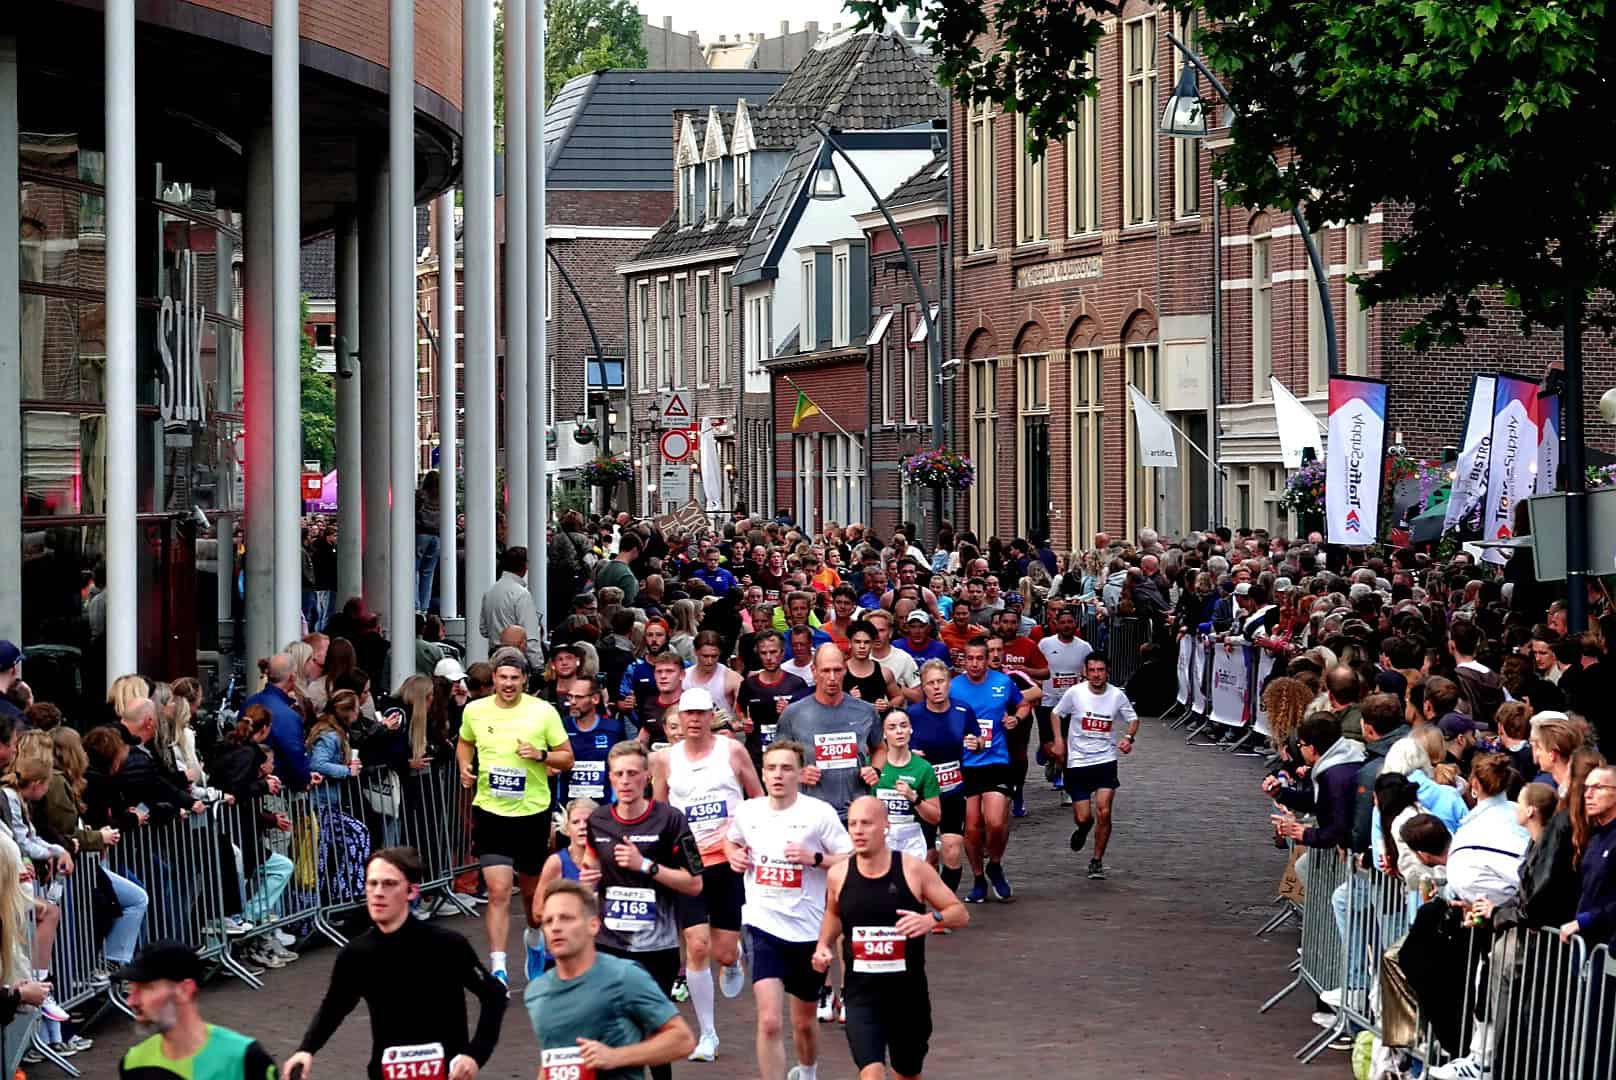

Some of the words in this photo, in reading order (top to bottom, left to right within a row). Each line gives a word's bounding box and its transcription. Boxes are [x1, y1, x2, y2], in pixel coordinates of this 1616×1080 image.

[1470, 436, 1491, 481] BISTRO
[821, 743, 852, 756] 2804
[492, 775, 520, 787] 3964
[571, 770, 600, 783] 4219
[690, 803, 722, 817] 4360
[760, 867, 795, 882] 2213
[611, 901, 648, 915] 4168
[863, 941, 895, 955] 946
[385, 1060, 443, 1080] 12147
[548, 1065, 580, 1080] 509
